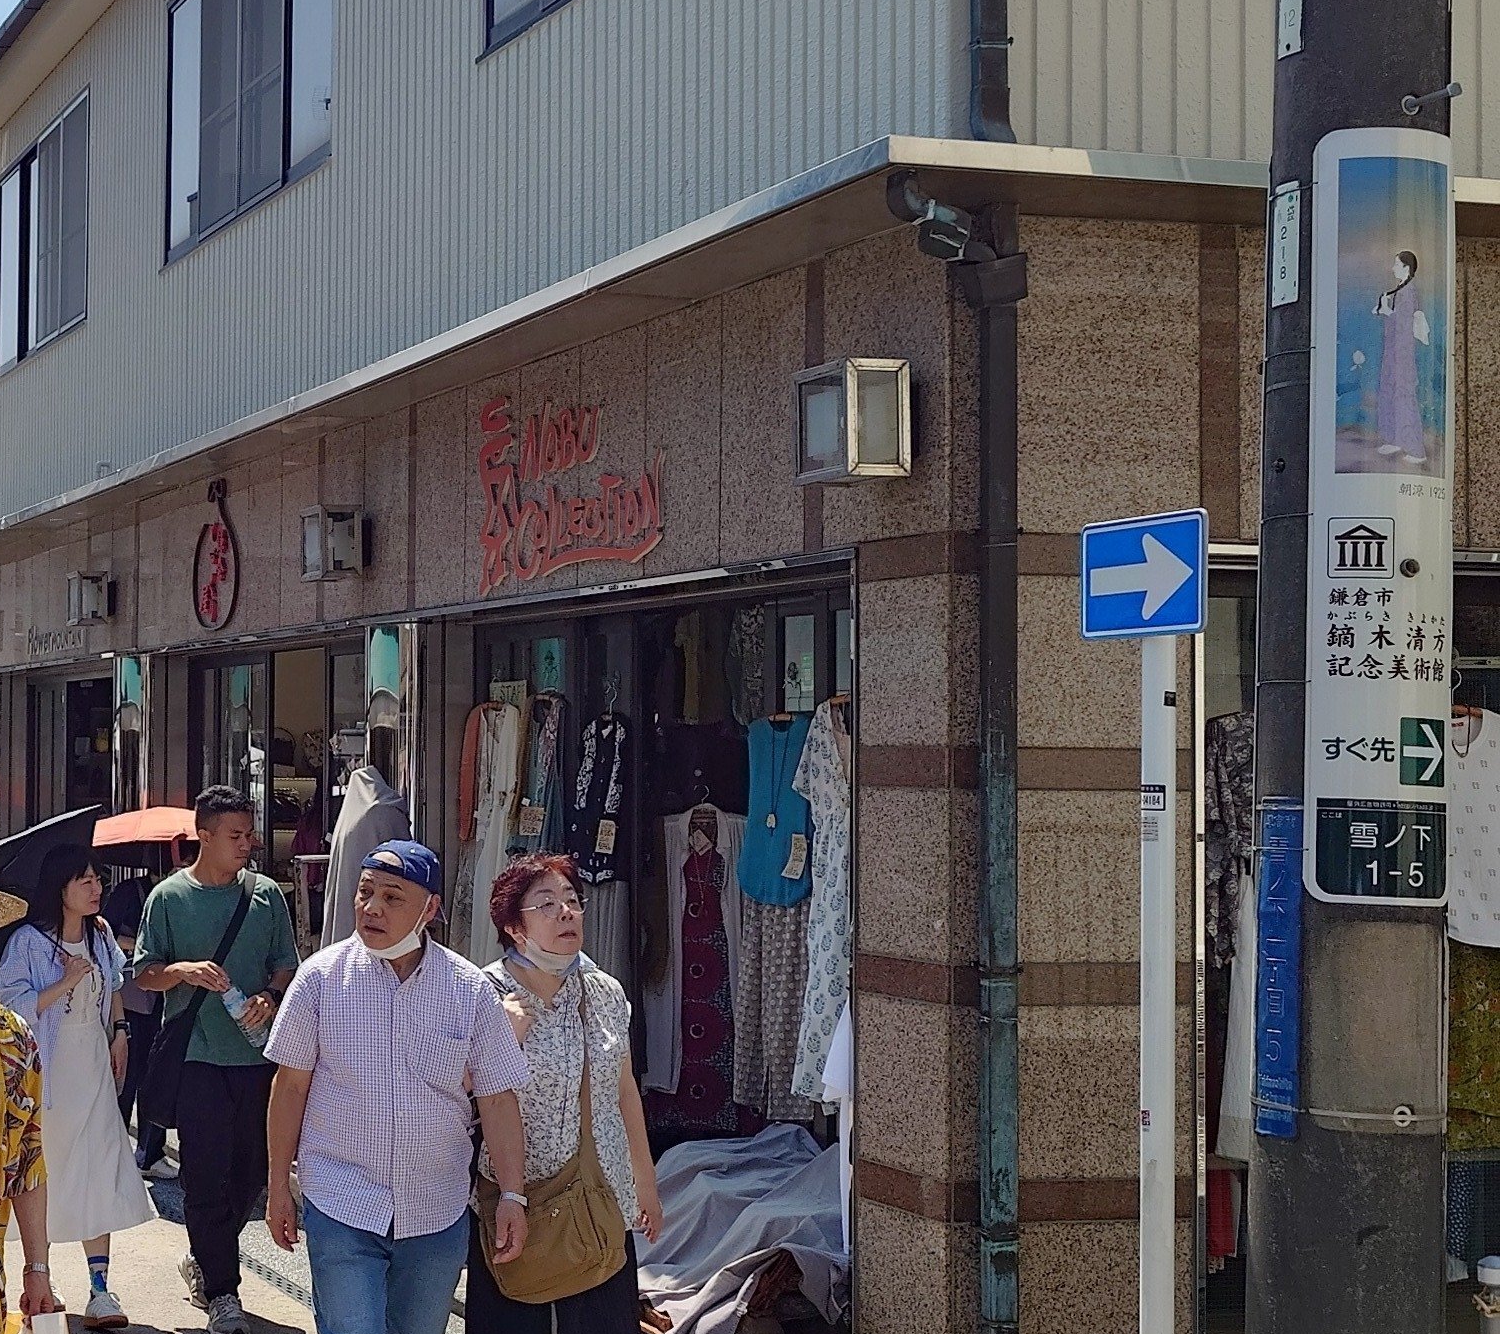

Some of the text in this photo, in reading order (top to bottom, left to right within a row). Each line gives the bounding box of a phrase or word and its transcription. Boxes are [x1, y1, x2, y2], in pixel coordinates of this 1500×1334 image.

[1328, 587, 1394, 607] 鎌倉市
[1326, 623, 1446, 653] 鏑木清方
[1325, 654, 1446, 683] 記念美術館
[1321, 736, 1396, 763] すぐ先
[1349, 822, 1432, 851] 雪ノ下
[1365, 860, 1424, 888] 1-5
